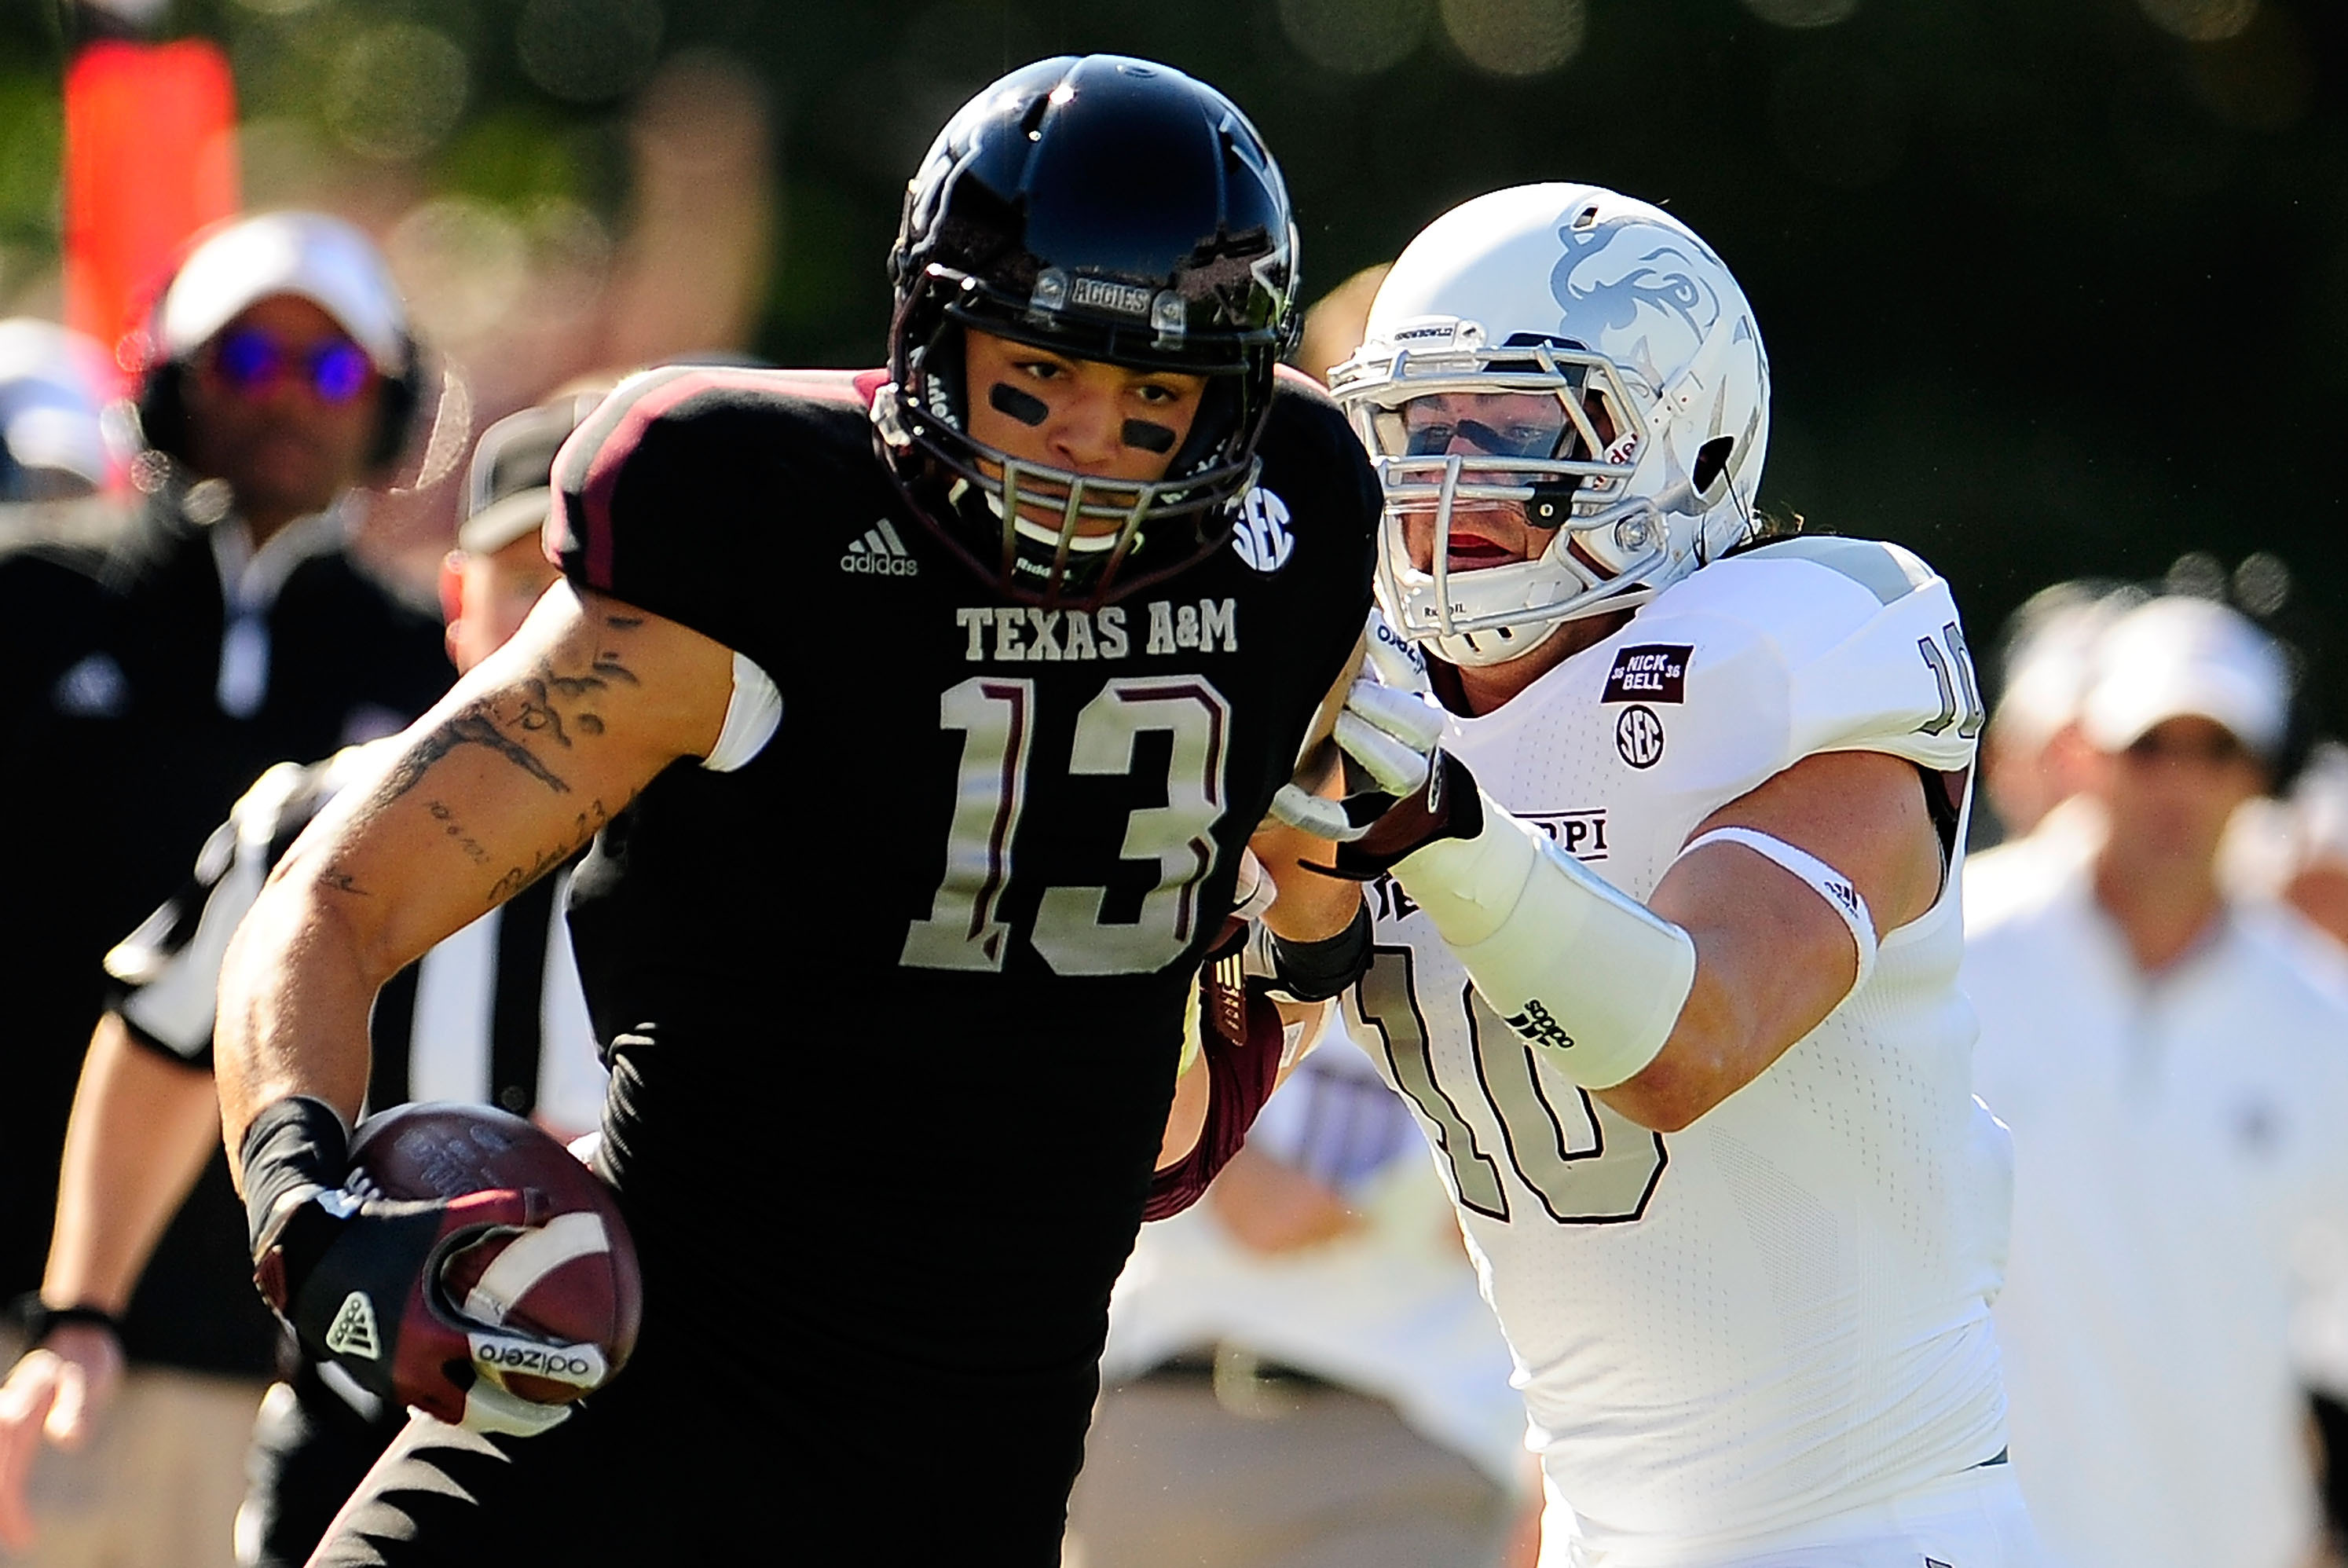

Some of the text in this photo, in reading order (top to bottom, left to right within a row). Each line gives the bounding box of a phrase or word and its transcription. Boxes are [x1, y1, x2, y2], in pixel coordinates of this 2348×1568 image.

[1071, 277, 1150, 313] AGGIES
[1232, 486, 1294, 572] SEC
[840, 551, 918, 576] adidas
[956, 599, 1238, 661] TEXAS A&M
[1622, 672, 1663, 691] BELL
[1627, 654, 1669, 672] NICK
[1665, 665, 1681, 678] 36
[1619, 709, 1661, 764] SEC
[899, 674, 1231, 976] 13
[1524, 999, 1575, 1049] adidas
[1354, 945, 1669, 1225] 10
[479, 1343, 589, 1375] adizero
